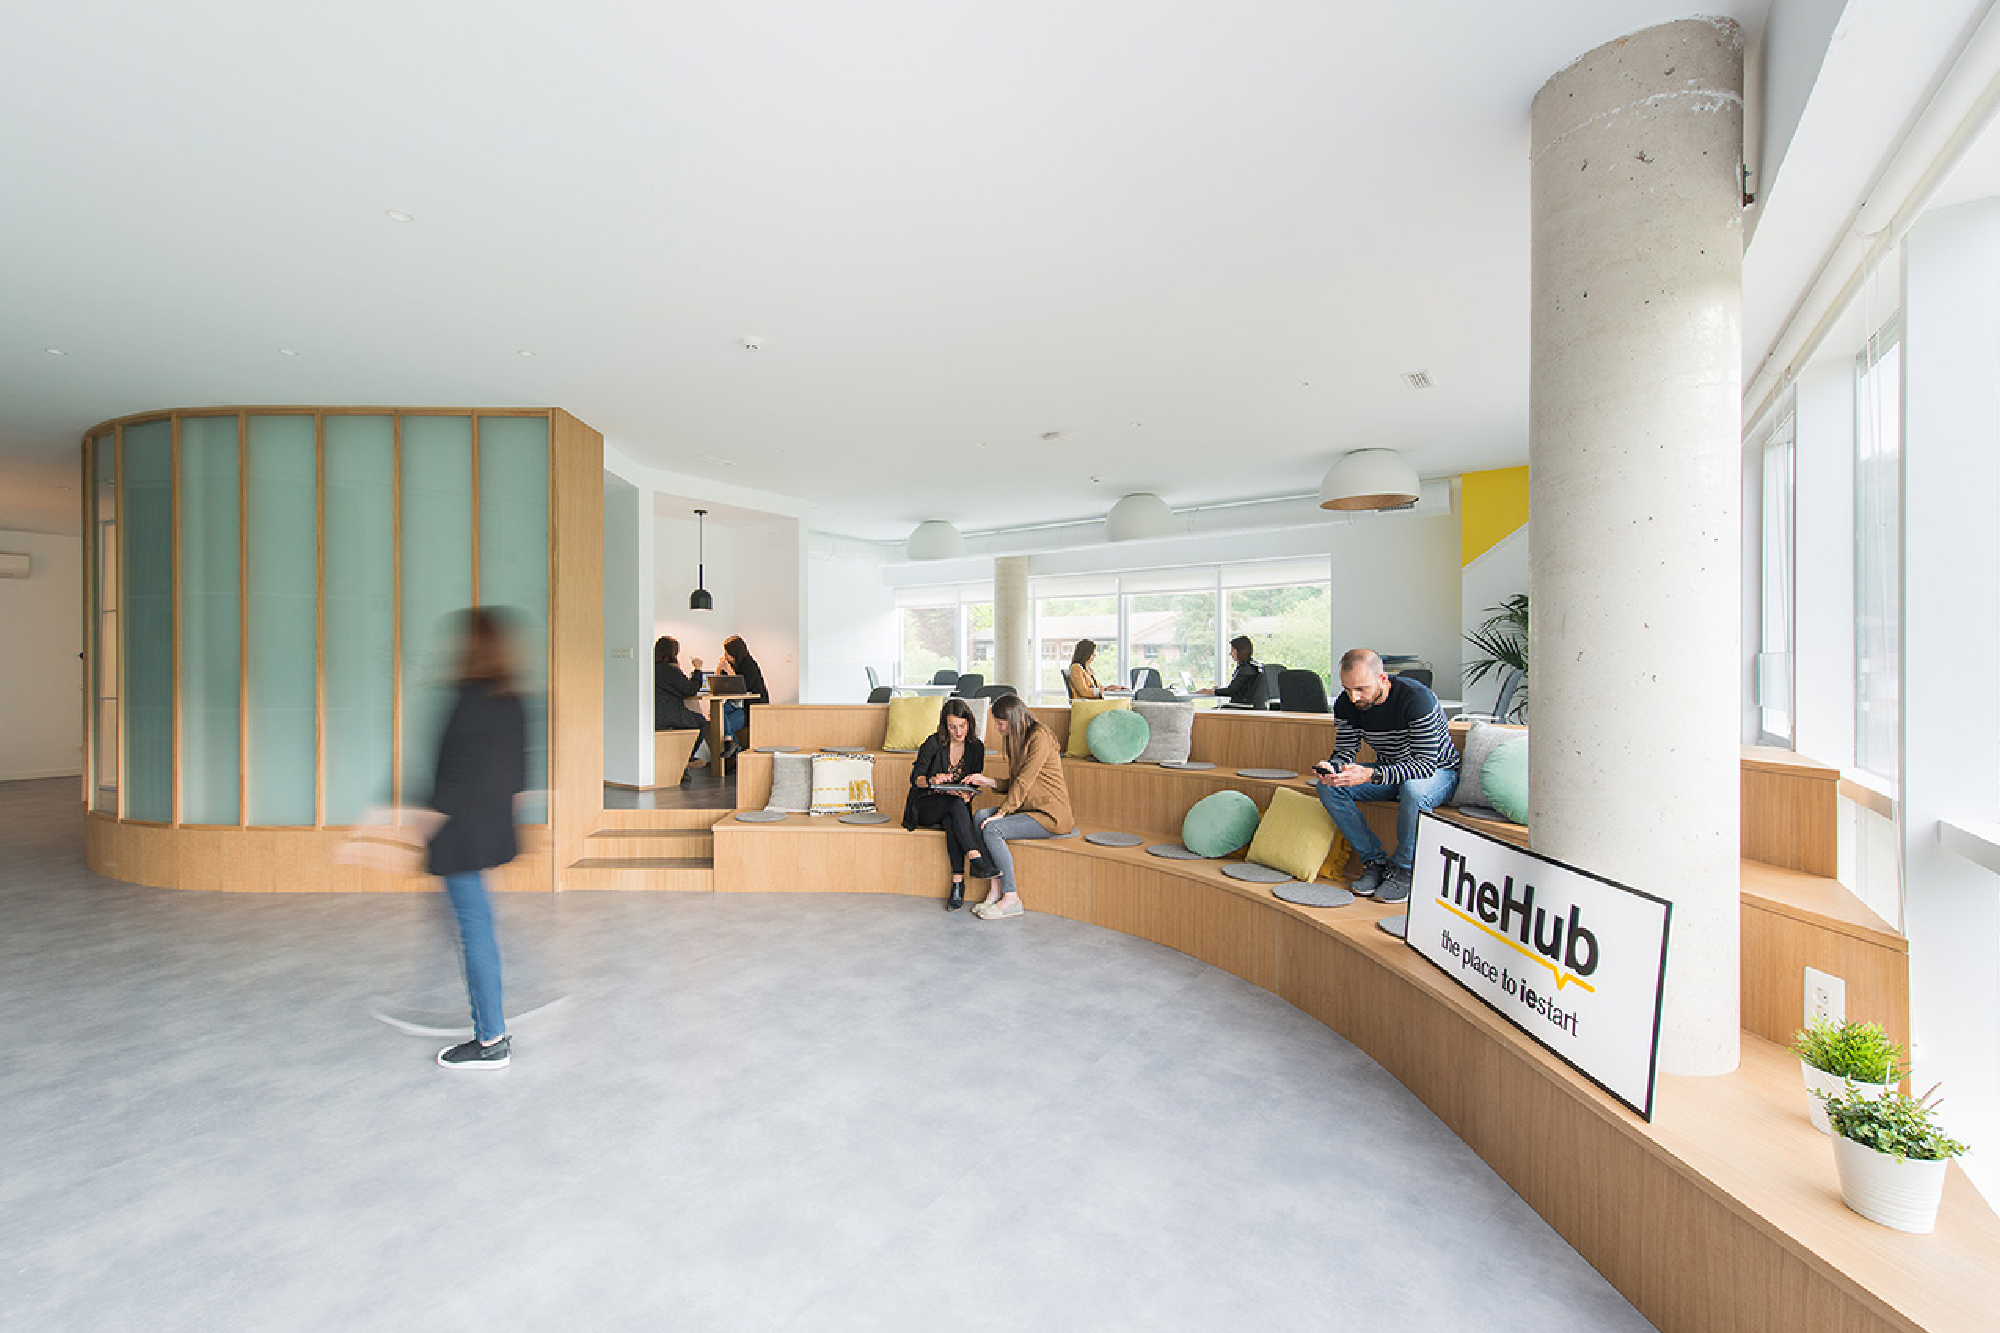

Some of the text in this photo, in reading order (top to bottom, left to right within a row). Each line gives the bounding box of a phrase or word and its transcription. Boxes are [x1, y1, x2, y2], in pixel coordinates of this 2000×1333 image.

[1440, 846, 1599, 977] TheHub
[1441, 930, 1578, 1037] the place to iestart
